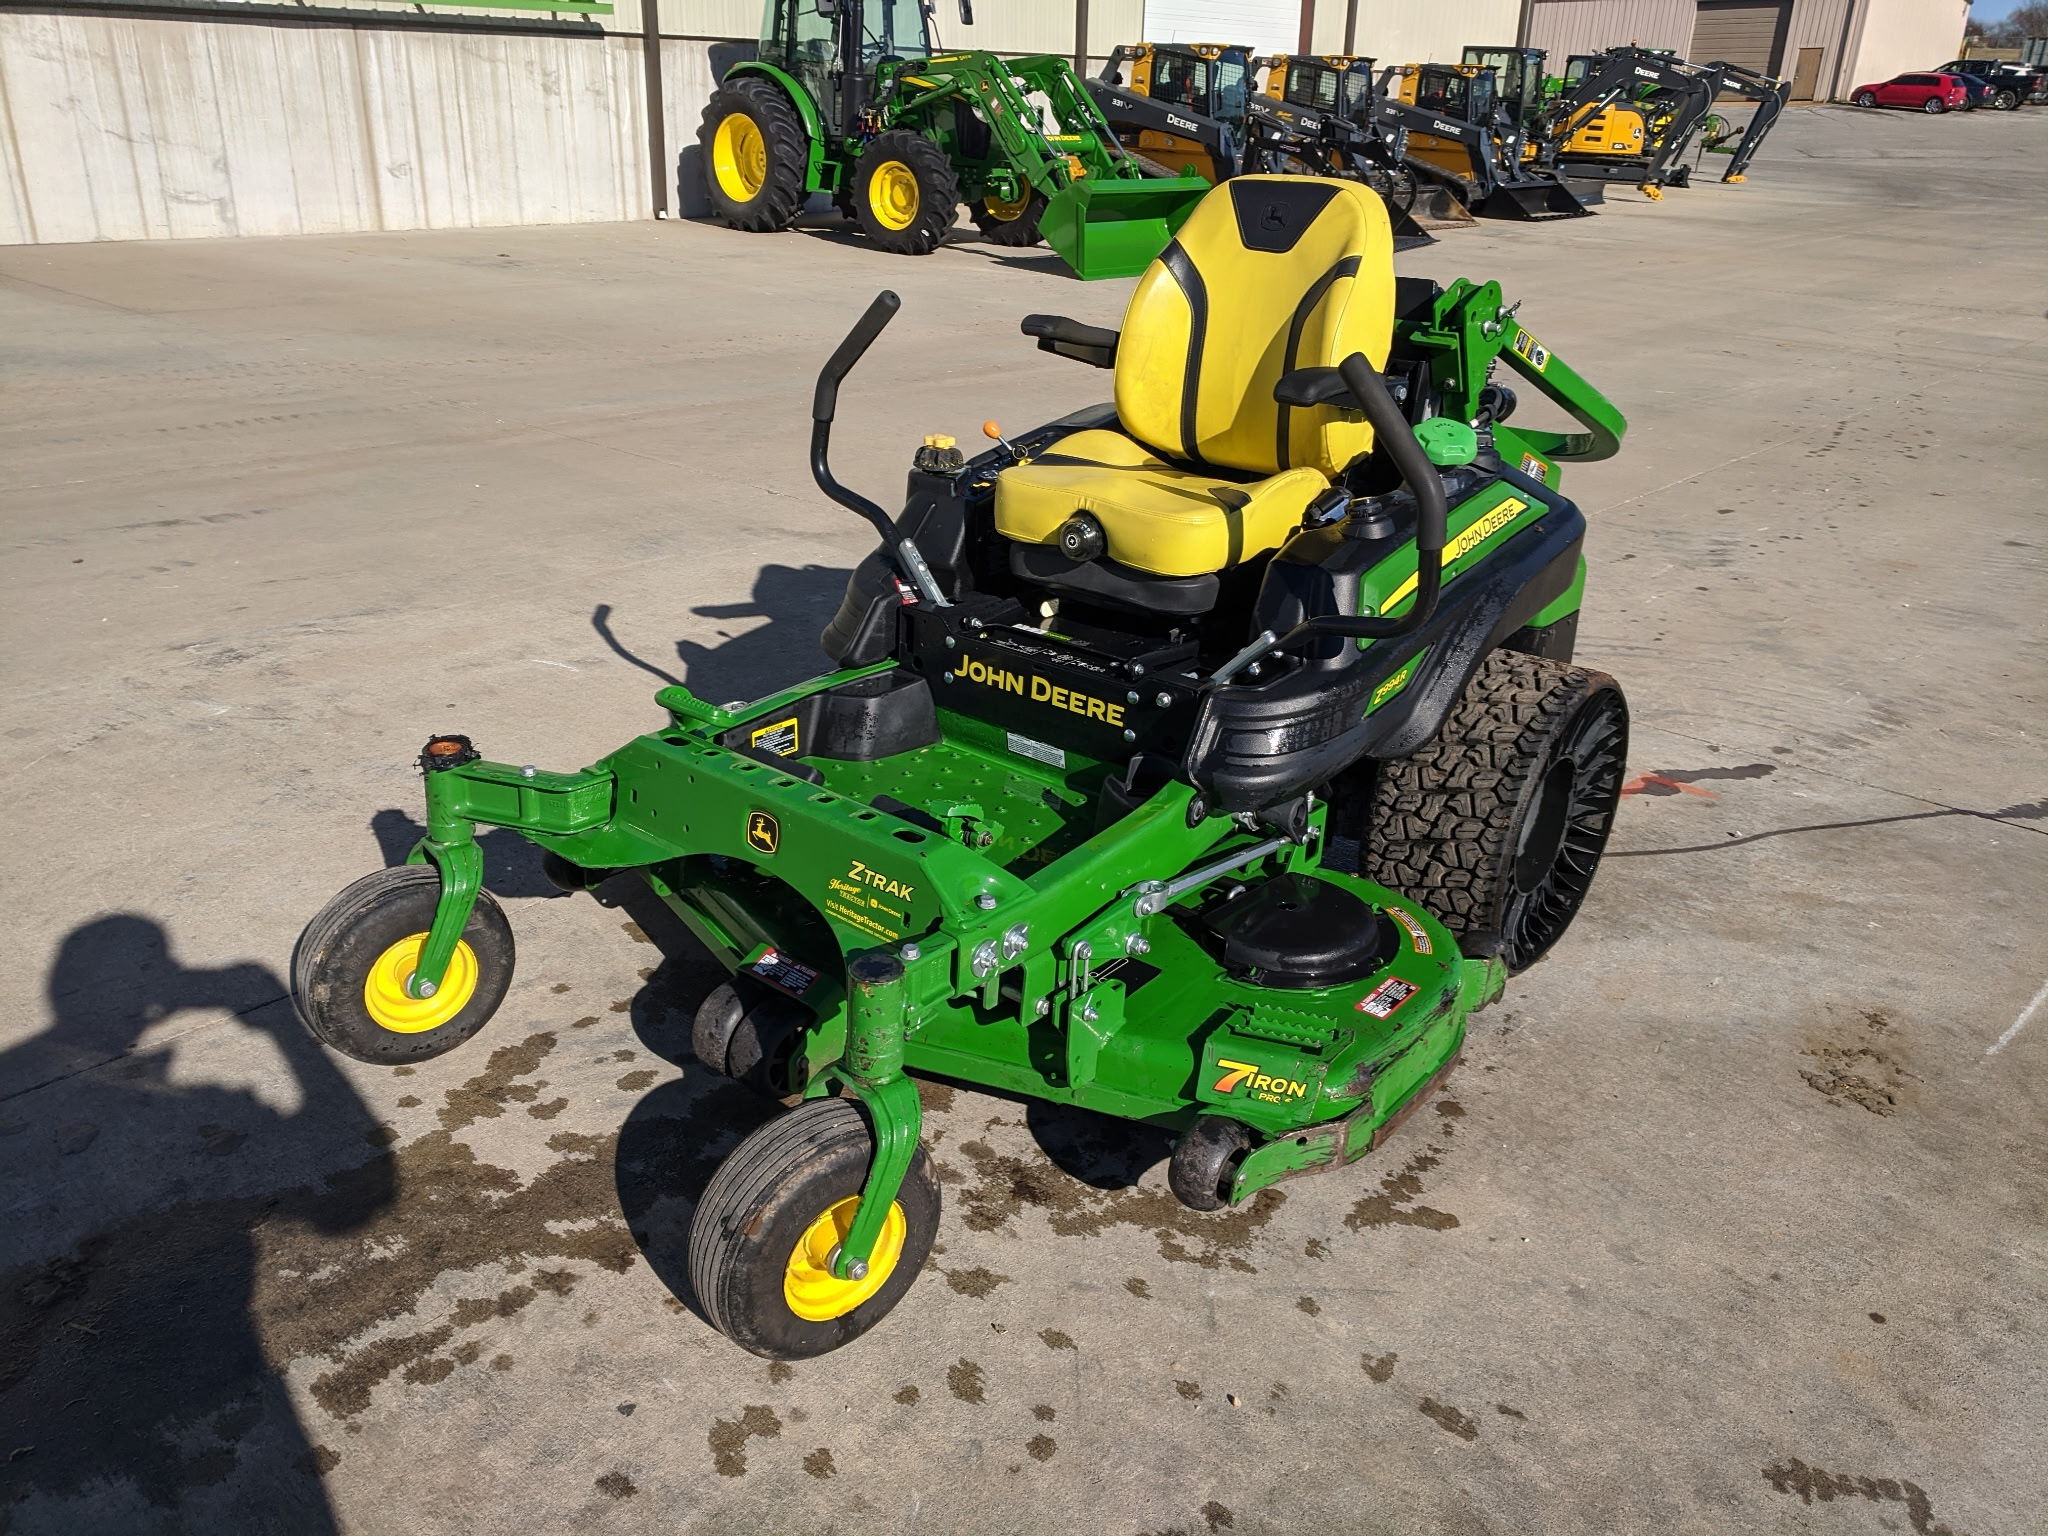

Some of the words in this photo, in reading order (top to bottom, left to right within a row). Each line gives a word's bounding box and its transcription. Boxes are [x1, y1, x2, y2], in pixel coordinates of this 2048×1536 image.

[1635, 66, 1660, 80] DEERE
[1166, 113, 1199, 132] DEERE
[1433, 120, 1462, 135] DEERE
[1455, 526, 1482, 557] JOHN
[1482, 503, 1515, 535] DEERE
[954, 654, 1024, 696] JOHN
[1030, 675, 1126, 728] DEERE
[828, 878, 862, 895] Heritage
[847, 860, 915, 902] ZTRAK
[826, 899, 839, 911] Visit
[839, 905, 899, 940] HeritageTractor.com
